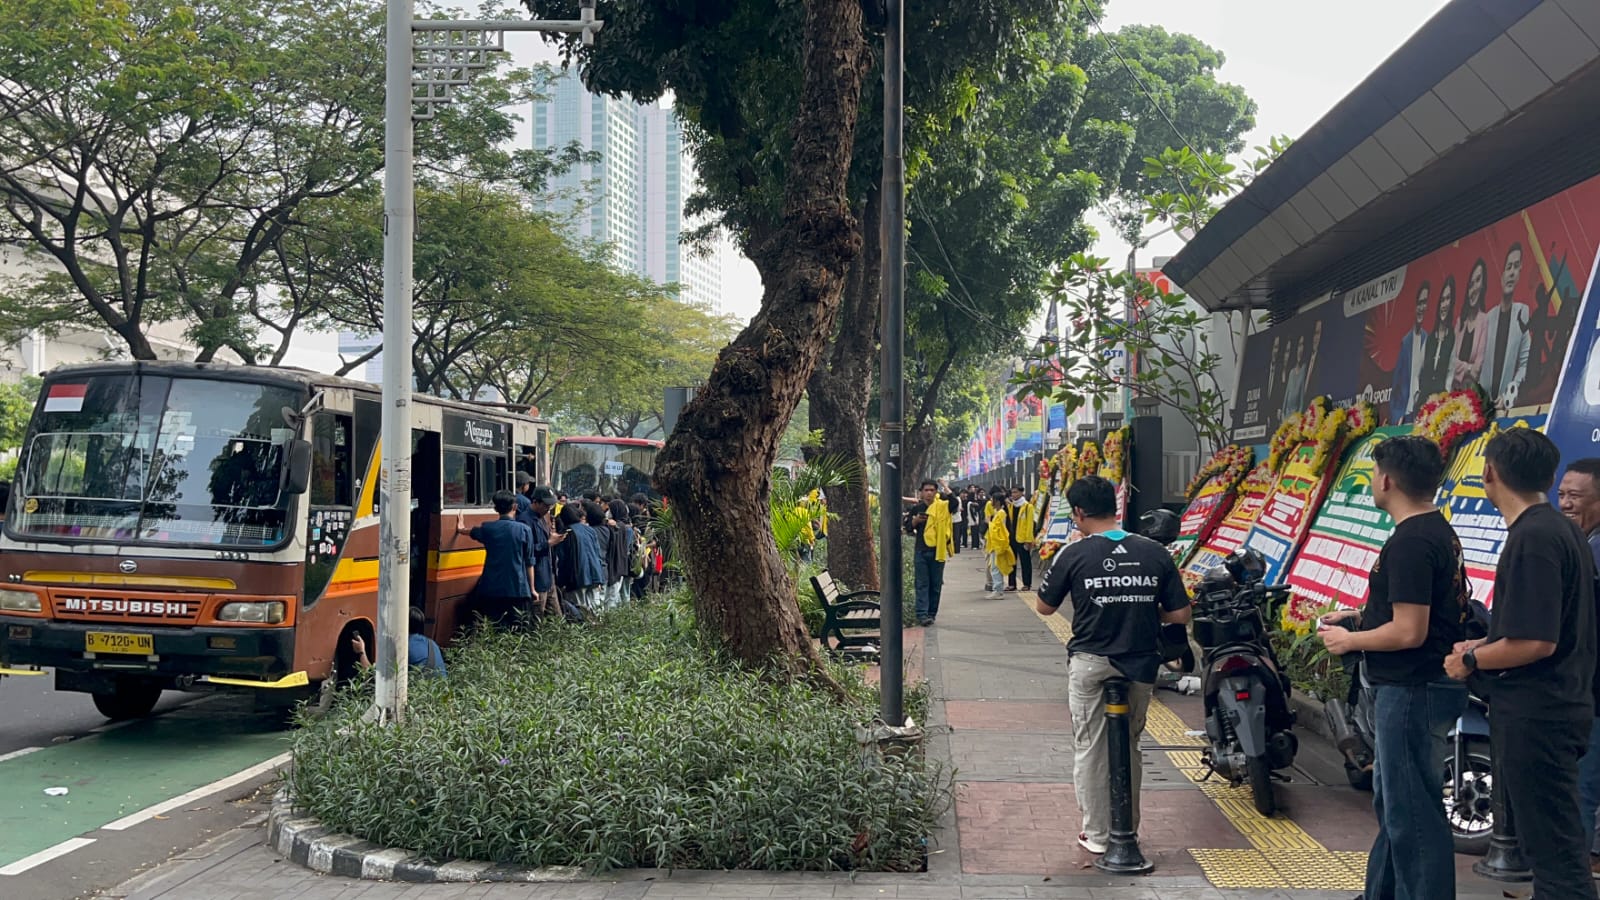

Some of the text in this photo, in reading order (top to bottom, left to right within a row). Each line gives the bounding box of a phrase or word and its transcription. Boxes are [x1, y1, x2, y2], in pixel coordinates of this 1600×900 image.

[1356, 283, 1379, 305] KANAL
[1380, 275, 1398, 297] TVRI
[1374, 388, 1393, 405] SPORT
[1084, 576, 1159, 590] PETRONAS
[1096, 594, 1156, 605] CROWDSTRIKE
[87, 634, 95, 646] B
[137, 636, 151, 649] UN
